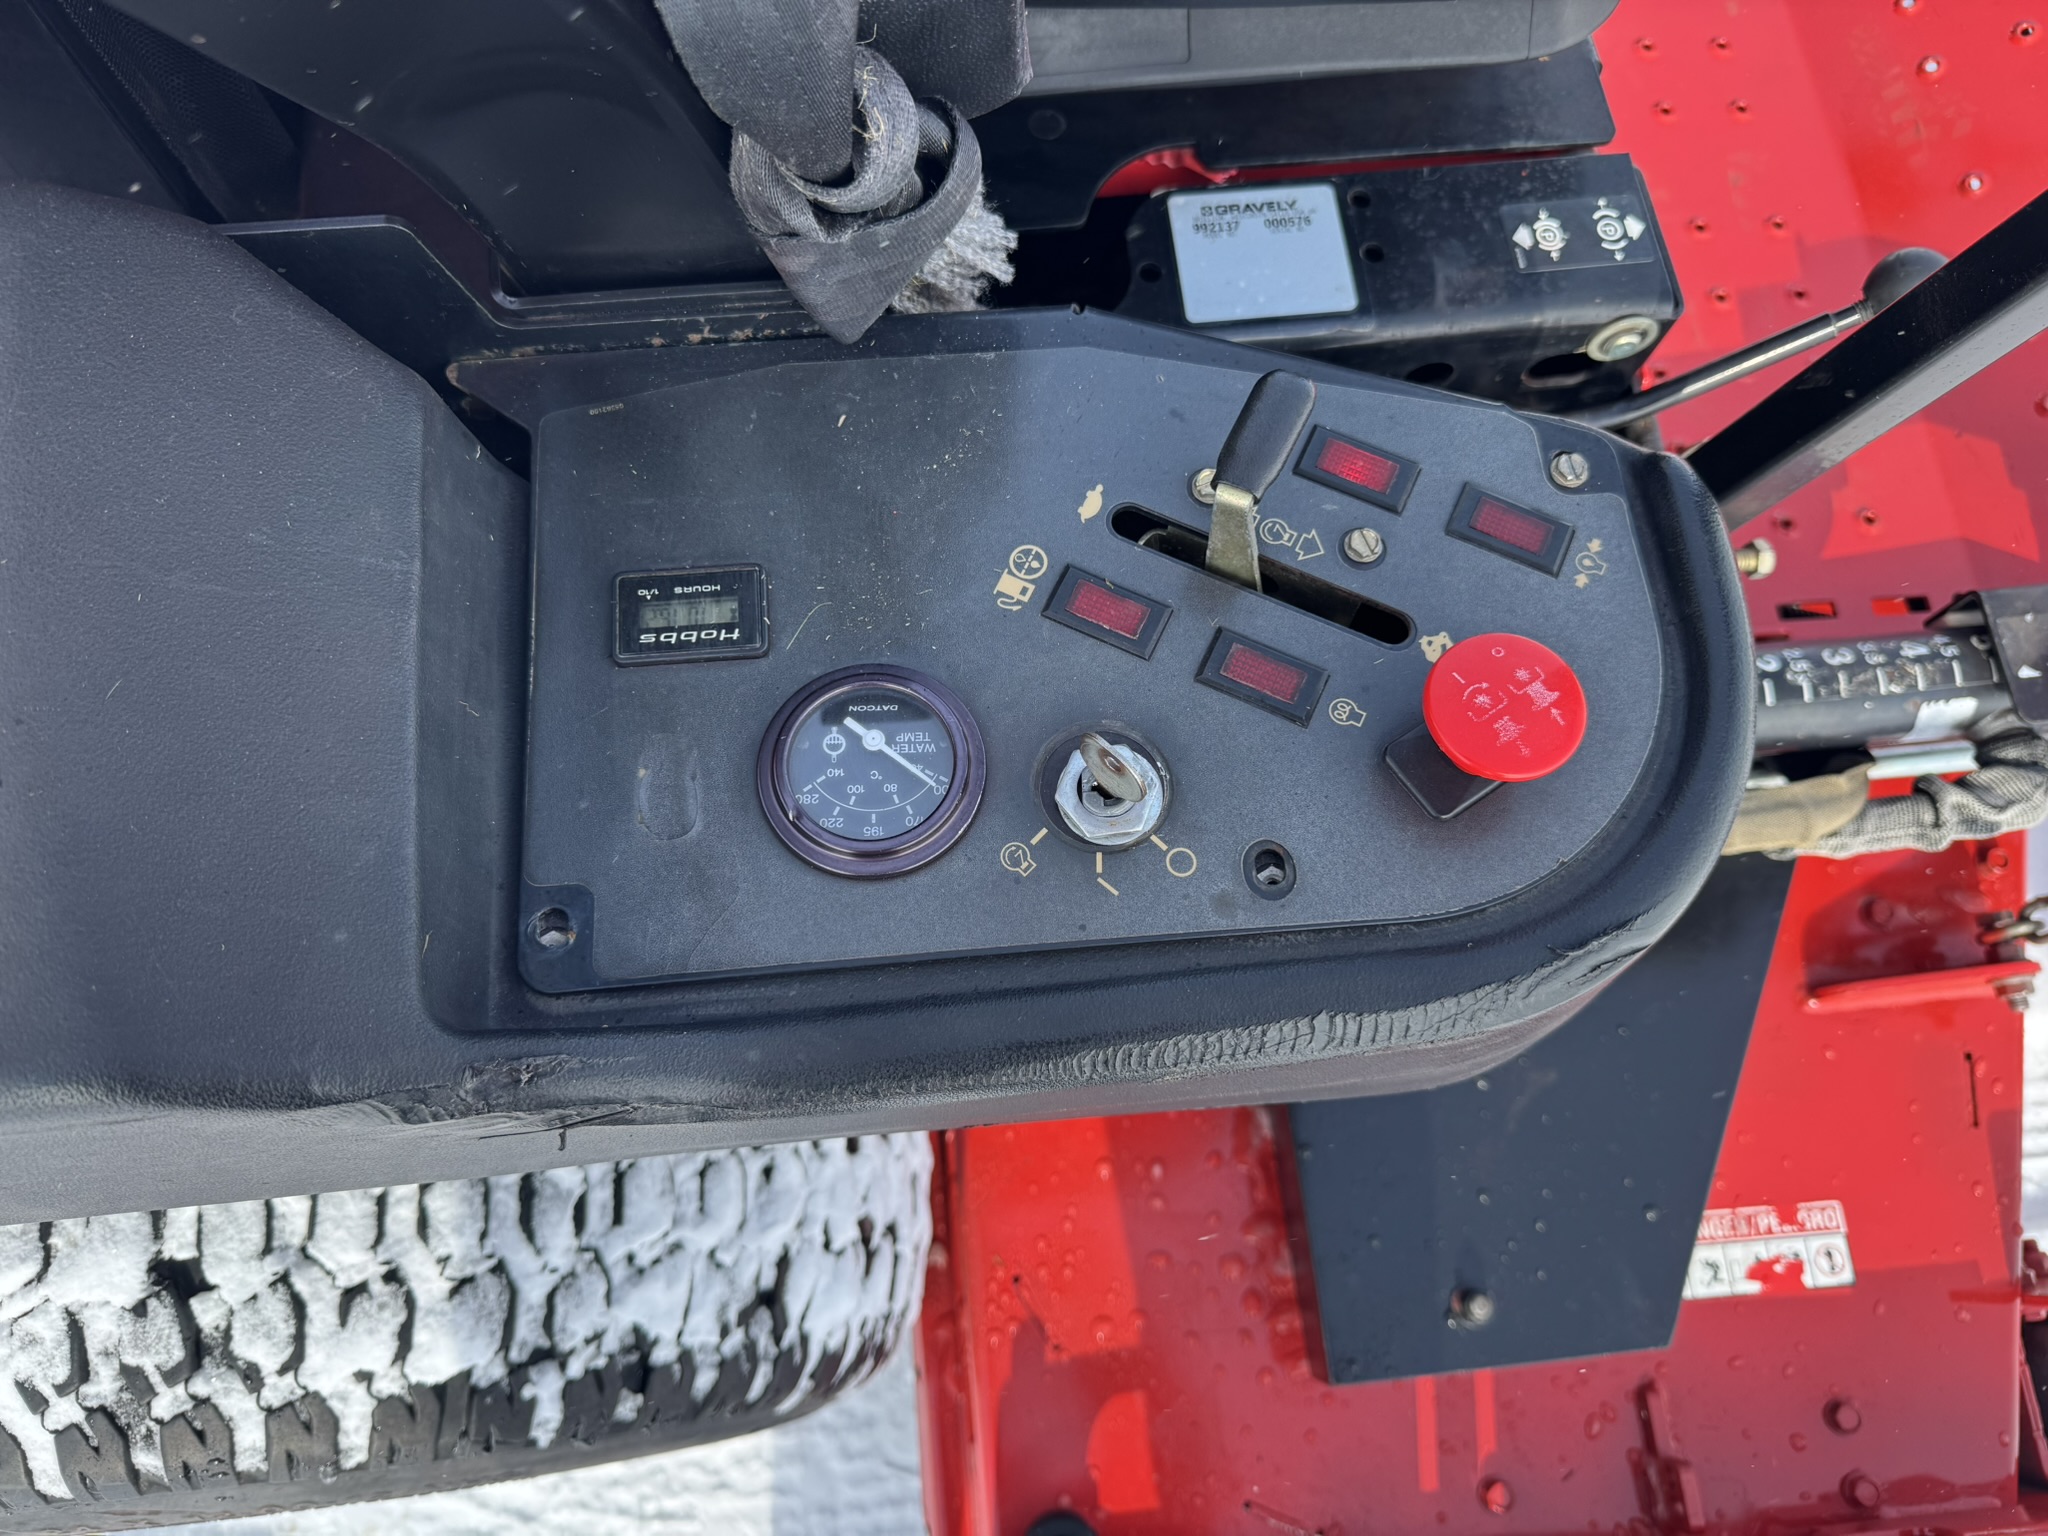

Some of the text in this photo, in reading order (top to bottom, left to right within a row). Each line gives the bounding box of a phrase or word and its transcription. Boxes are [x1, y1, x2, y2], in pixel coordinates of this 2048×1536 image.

[1214, 200, 1297, 216] GRAVELY
[1192, 220, 1240, 235] 992137
[637, 584, 721, 596] HOURS 1/10
[639, 628, 741, 644] Hobbs
[1821, 646, 1856, 666] 3
[848, 704, 899, 712] DATCON
[896, 732, 932, 742] TEMP
[891, 743, 937, 753] WATER
[827, 768, 845, 778] 140
[847, 784, 866, 794] 100
[883, 783, 898, 793] 80
[795, 794, 820, 805] 280
[819, 817, 844, 828] 220
[863, 826, 885, 837] 195
